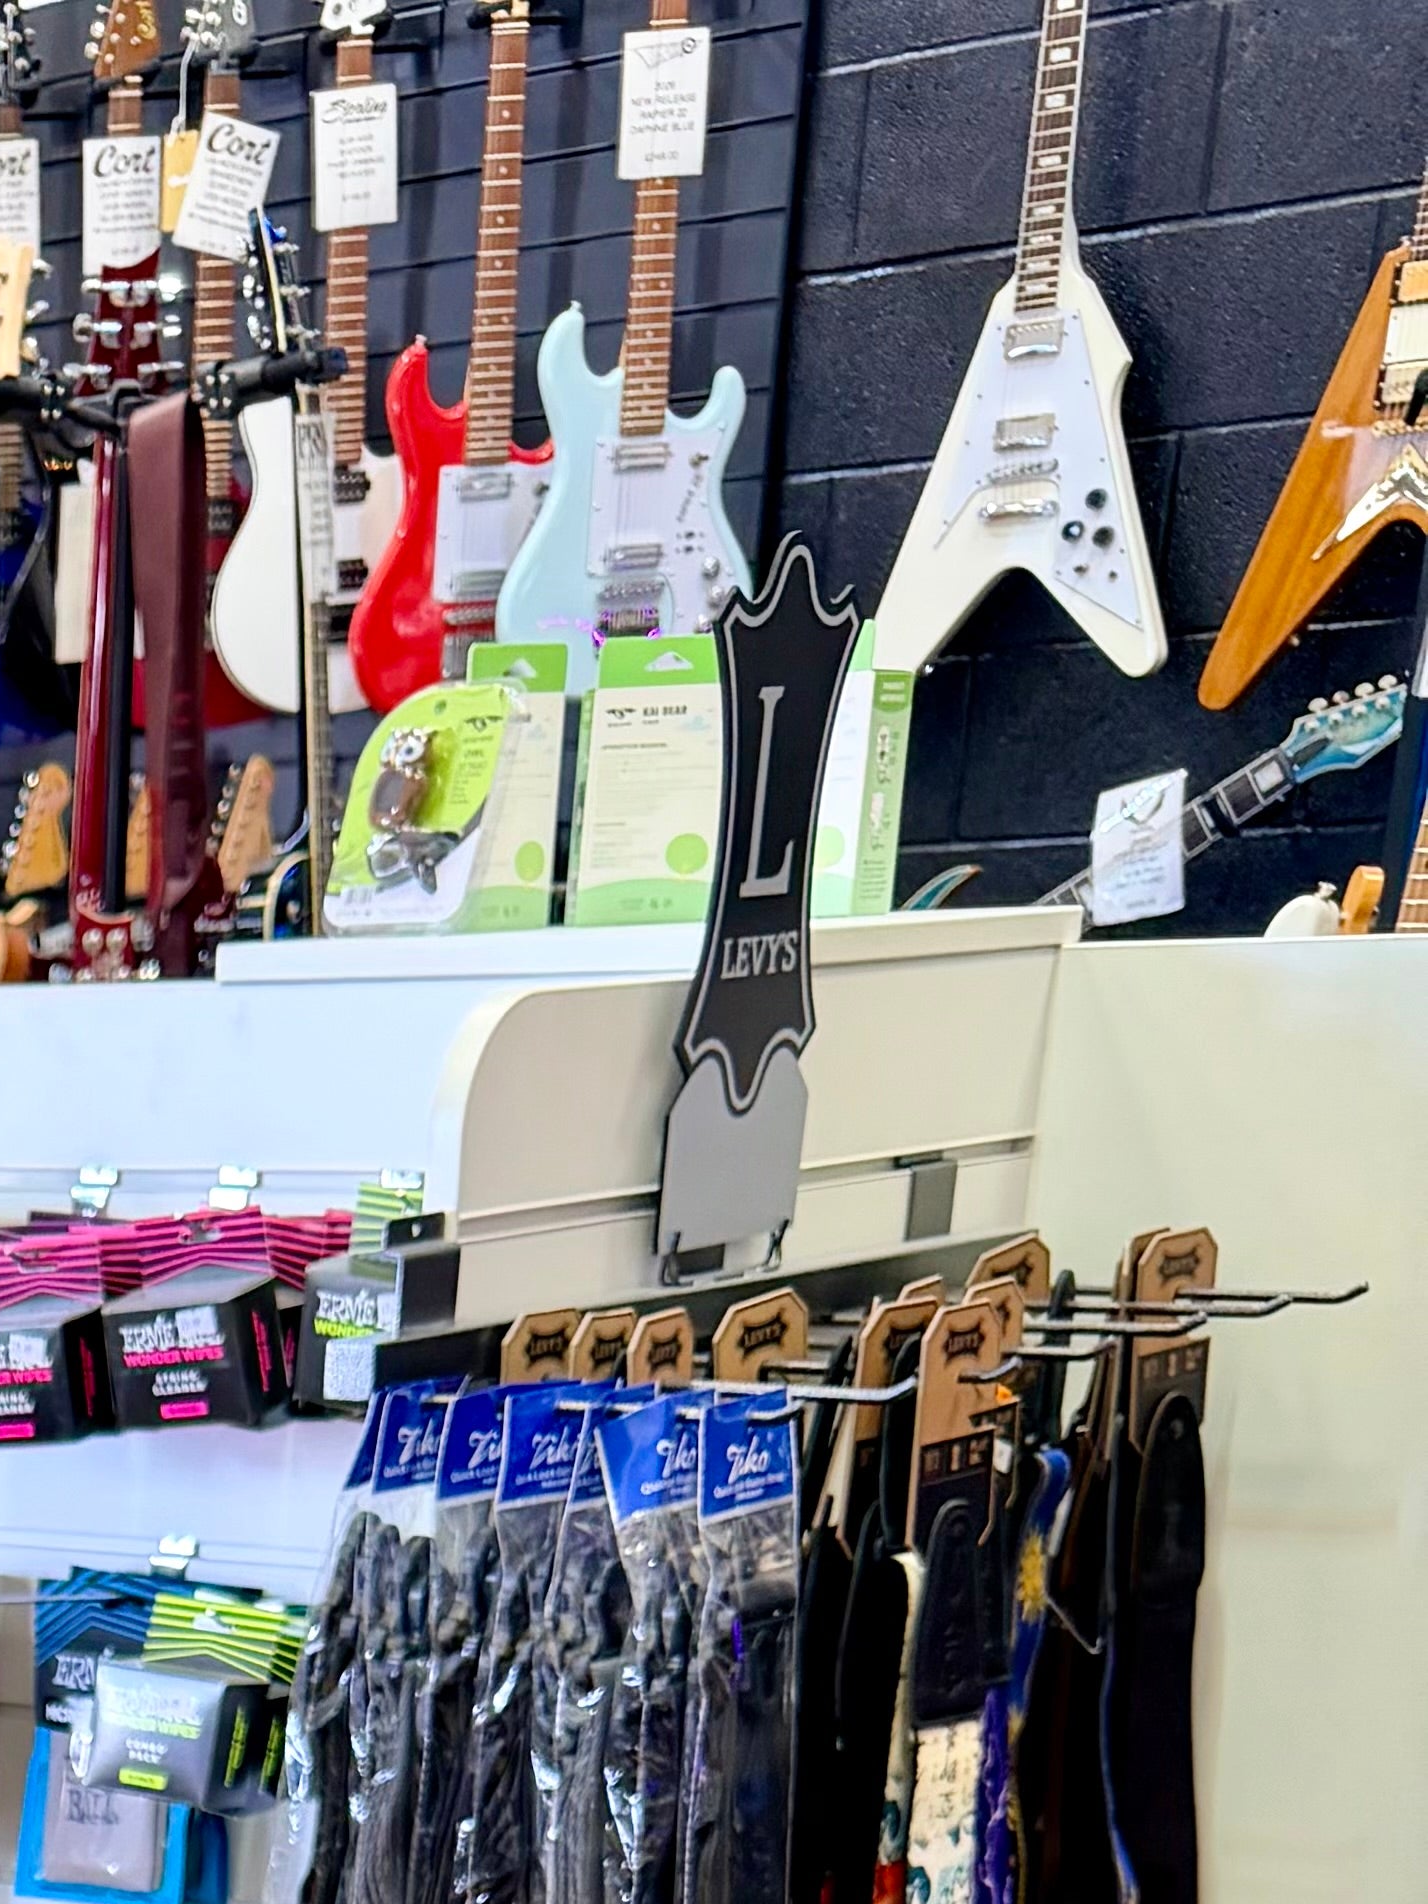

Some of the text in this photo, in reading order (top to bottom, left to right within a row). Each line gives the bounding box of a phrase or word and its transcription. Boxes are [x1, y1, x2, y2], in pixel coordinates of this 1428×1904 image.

[94, 145, 155, 177] Cort
[207, 122, 271, 165] Cort
[720, 931, 799, 979] LEVY'S
[316, 1288, 377, 1327] ERNIE
[119, 1313, 175, 1353] ERNIE
[13, 1368, 53, 1384] WIPES
[123, 1345, 225, 1369] WONDER WIPES
[398, 1416, 442, 1466] Tik
[726, 1434, 770, 1484] Tiko
[52, 1653, 94, 1691] ERN
